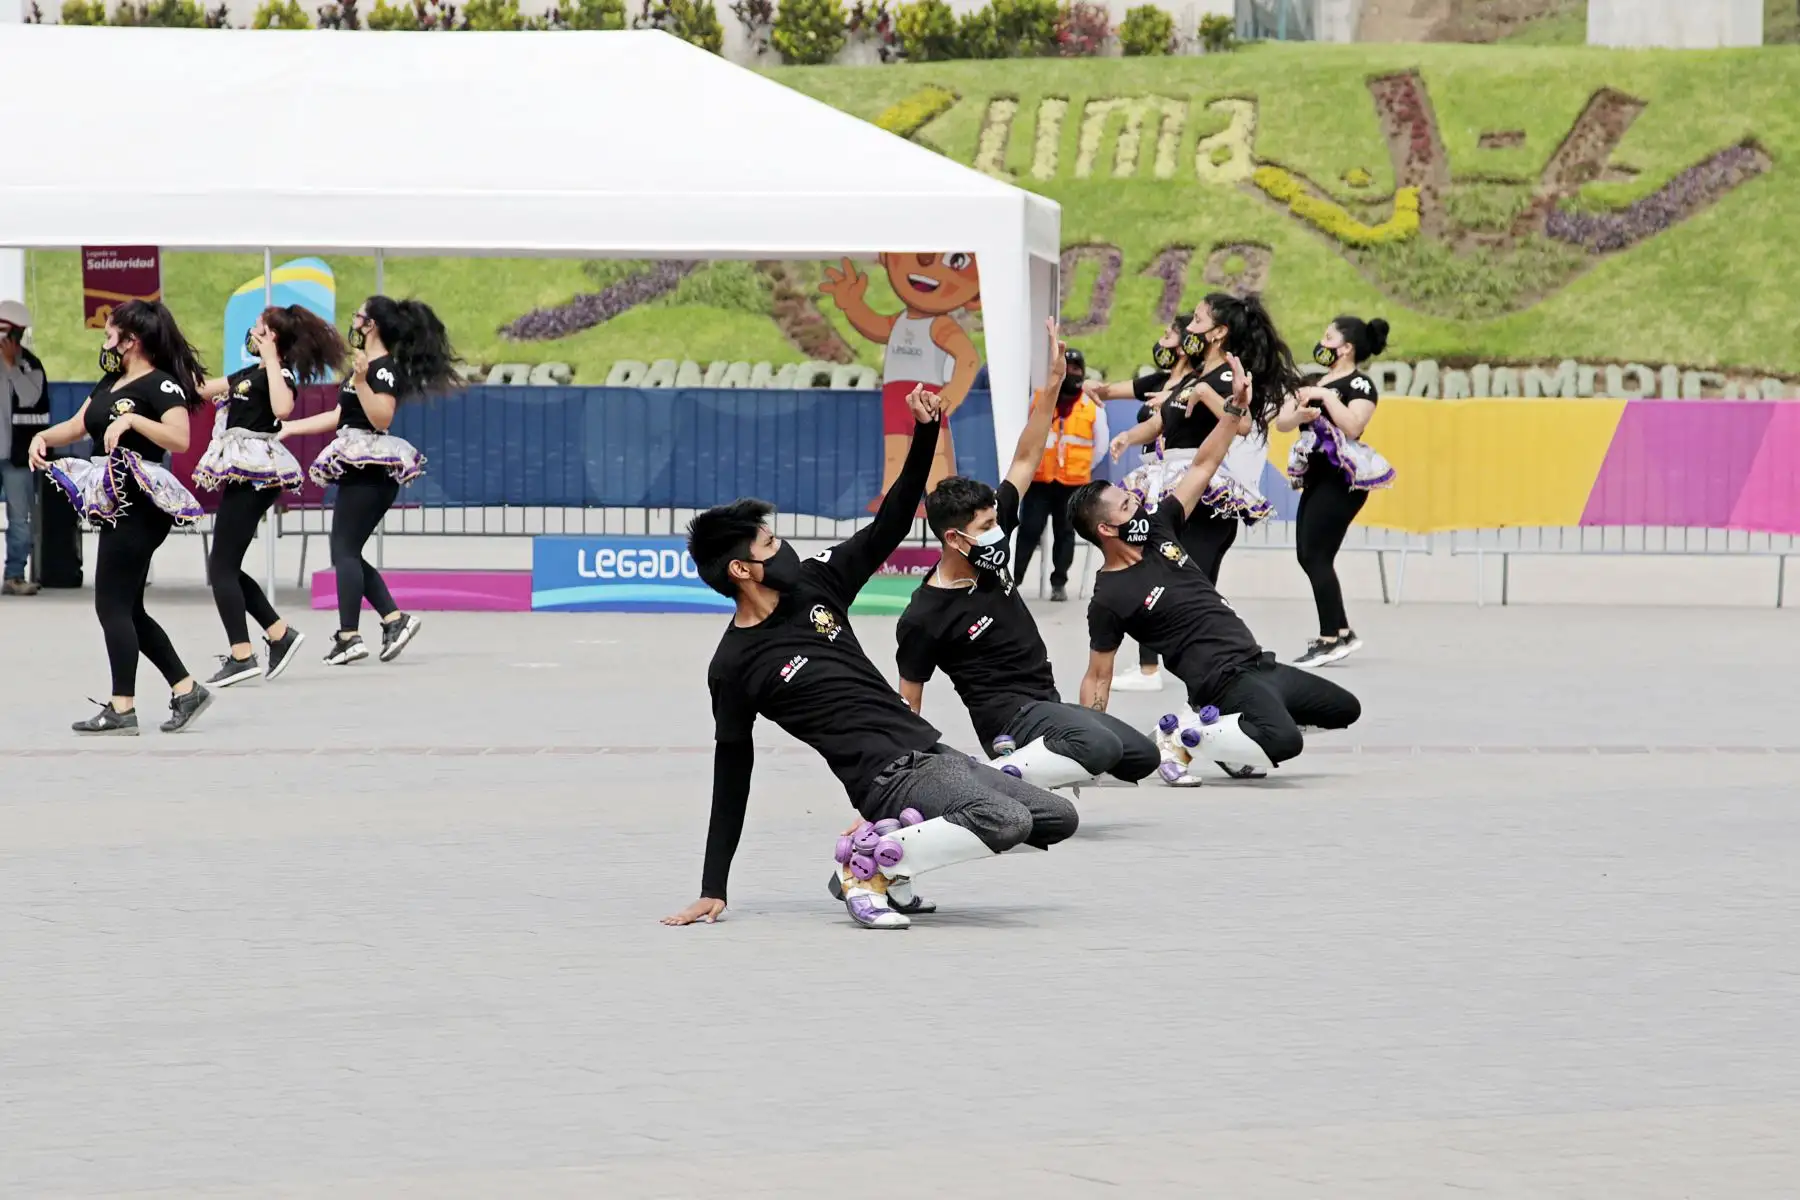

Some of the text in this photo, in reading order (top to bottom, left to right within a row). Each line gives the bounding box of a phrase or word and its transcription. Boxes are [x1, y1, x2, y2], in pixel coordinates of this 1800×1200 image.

[86, 257, 155, 271] Solidaridad
[1128, 518, 1149, 534] 20
[1127, 533, 1148, 542] AÑOS
[980, 545, 1006, 566] 20
